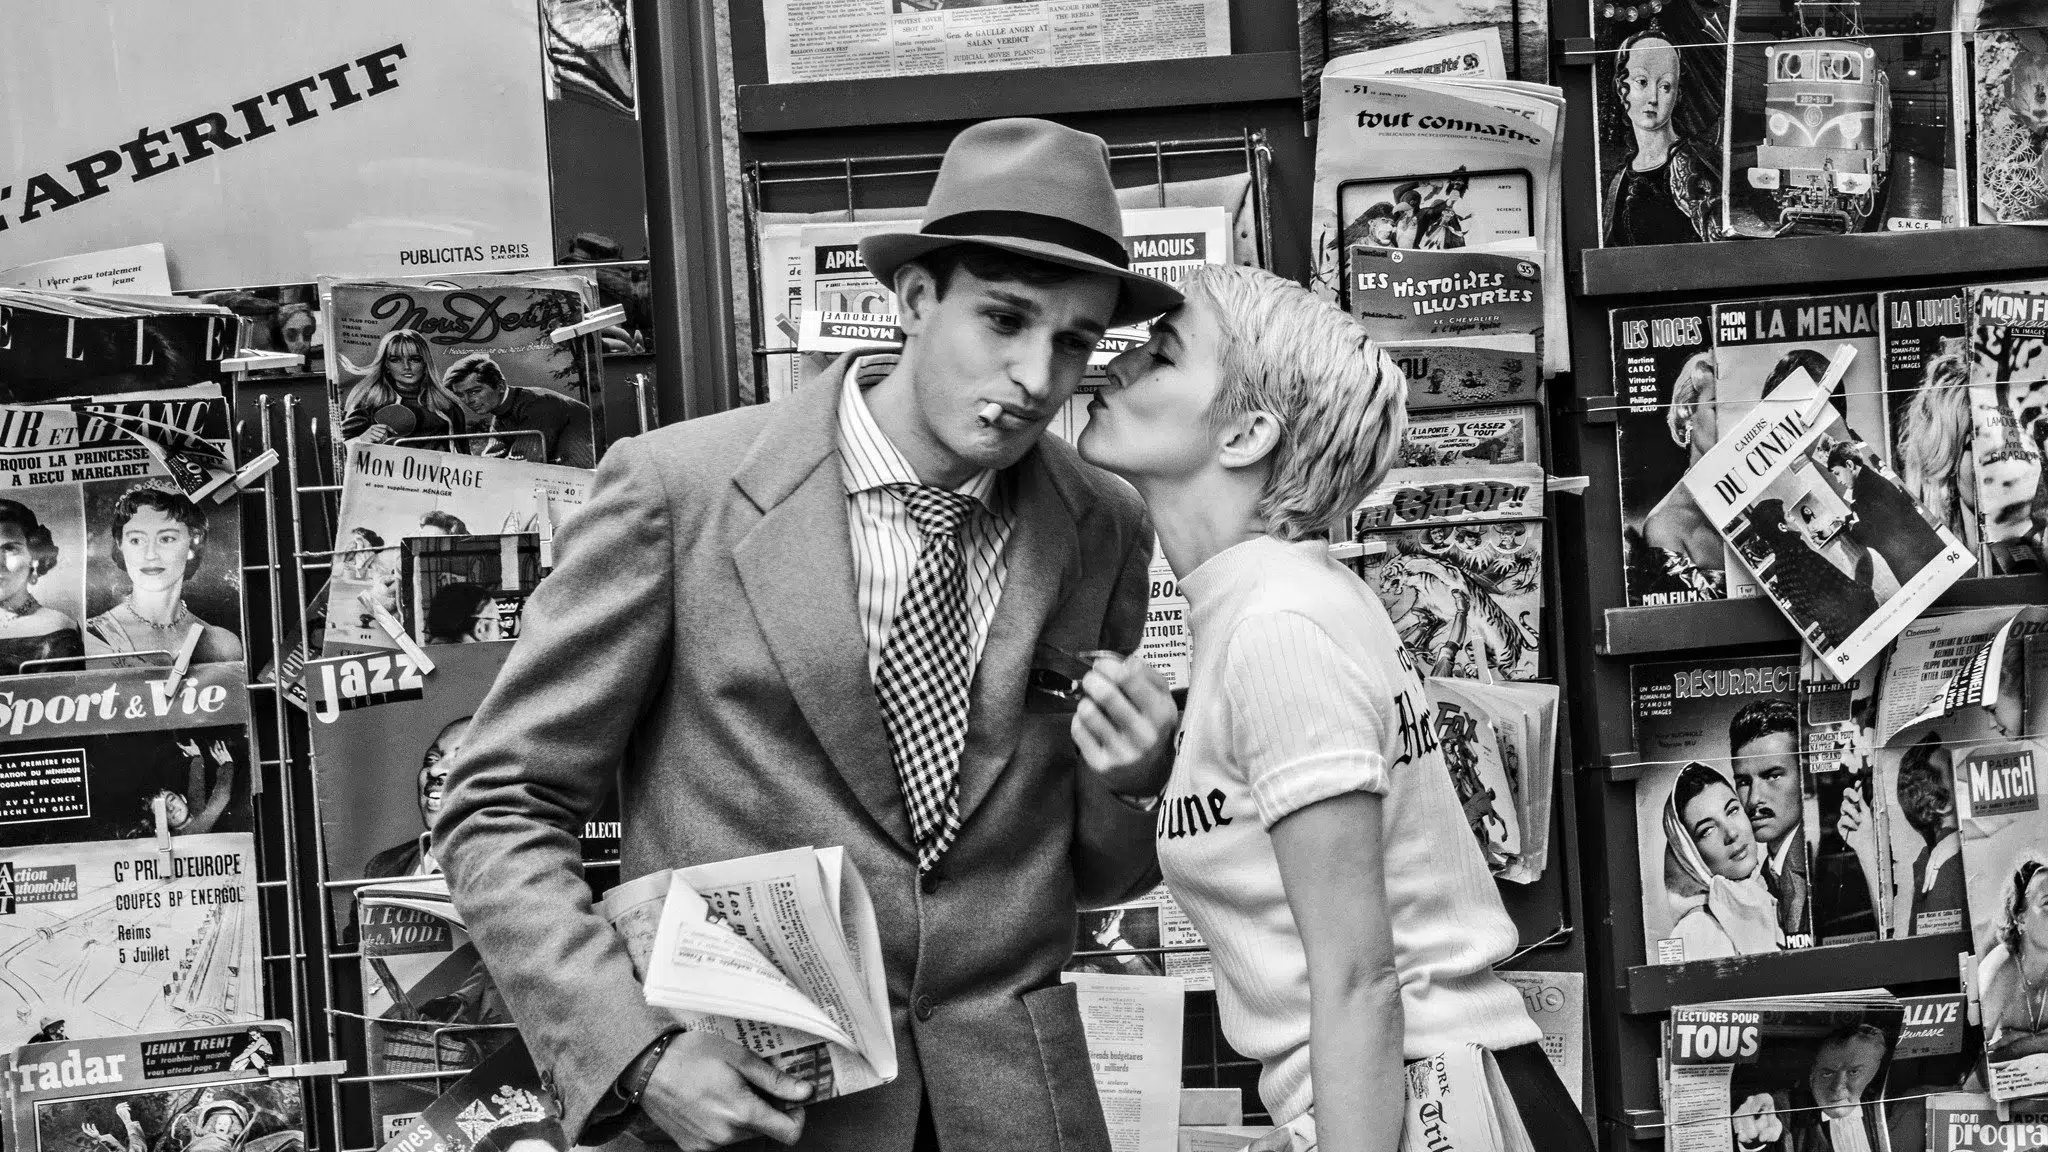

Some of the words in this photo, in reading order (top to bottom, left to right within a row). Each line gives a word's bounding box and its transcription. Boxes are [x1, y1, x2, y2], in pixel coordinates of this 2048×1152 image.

[964, 30, 973, 38] de
[975, 27, 1006, 36] GAULLE
[1038, 24, 1049, 32] AT
[996, 35, 1029, 45] VERDICT
[1356, 109, 1414, 128] tout
[1418, 115, 1541, 145] connaître
[400, 246, 484, 265] PUBLICITAS
[490, 243, 529, 254] PARIS
[1133, 238, 1196, 259] MAQUIS
[825, 250, 868, 270] APRE
[1393, 253, 1401, 261] 26
[1520, 264, 1532, 274] 35
[46, 277, 70, 287] Votre
[73, 272, 93, 283] peau
[95, 265, 142, 278] totalement
[112, 276, 136, 286] jeune
[1357, 272, 1389, 291] LES
[1393, 270, 1505, 299] HISTOIRES
[371, 293, 473, 333] Nous
[1891, 301, 1912, 329] LA
[1981, 294, 2029, 321] MON
[1449, 315, 1500, 324] CHEVALIER
[1720, 311, 1746, 326] MON
[1755, 308, 1786, 339] LA
[831, 325, 895, 340] MAQUIS
[1622, 319, 1649, 350] LES
[1652, 315, 1703, 348] NOCES
[1720, 326, 1747, 342] FILM
[2022, 328, 2046, 336] IMAGES
[1891, 354, 1921, 362] D'AMOUR
[1901, 361, 1921, 369] IMAGES
[1628, 365, 1656, 373] CAROL
[1628, 376, 1656, 384] Vittorio
[1629, 385, 1639, 393] DE
[1640, 384, 1657, 393] SICA
[1629, 396, 1658, 405] Philippe
[1427, 426, 1449, 434] PORTE
[1466, 422, 1507, 430] CASSEZ
[1734, 418, 1769, 450] CAHIERS
[49, 426, 78, 446] ET
[49, 455, 67, 468] LA
[74, 448, 149, 467] PRINCESSE
[12, 474, 22, 486] A
[72, 462, 149, 481] MARGARET
[1713, 466, 1749, 506] DU
[1642, 592, 1668, 606] MON
[1669, 590, 1698, 604] FILM
[1143, 640, 1187, 649] nouvelles
[1143, 650, 1187, 659] chinoises
[316, 653, 423, 724] jazz
[0, 682, 120, 735] Sport
[125, 695, 146, 719] &
[145, 677, 227, 717] Vie
[1651, 708, 1672, 716] IMAGES
[21, 759, 59, 767] PREMIÈRE
[1989, 756, 2020, 769] PARIS
[45, 767, 81, 775] MÉNISQUE
[1969, 752, 2035, 803] MATCH
[51, 776, 81, 785] COULEUR
[39, 795, 76, 804] FRANCE
[33, 806, 47, 814] UN
[135, 858, 170, 882] PRI
[174, 853, 242, 879] D'EUROPE
[116, 892, 161, 911] COUPES
[169, 891, 182, 907] BP
[191, 885, 244, 906] ENERGOL
[727, 890, 741, 917] Les
[118, 925, 151, 941] Reims
[389, 926, 450, 945] MODE
[119, 951, 126, 963] 5
[133, 946, 170, 963] Juillet
[1677, 1011, 1729, 1023] LECTURES
[1731, 1012, 1760, 1024] POUR
[1677, 1024, 1759, 1059] TOUS
[1895, 1027, 1945, 1047] jeunesse
[145, 1040, 187, 1056] JENNY
[193, 1036, 234, 1051] TRENT
[160, 1054, 201, 1064] troublante
[18, 1048, 126, 1093] radar
[167, 1065, 192, 1074] attend
[193, 1064, 213, 1073] page
[215, 1061, 221, 1070] 7
[1434, 1051, 1451, 1098] YORK
[1949, 1113, 1980, 1123] mon
